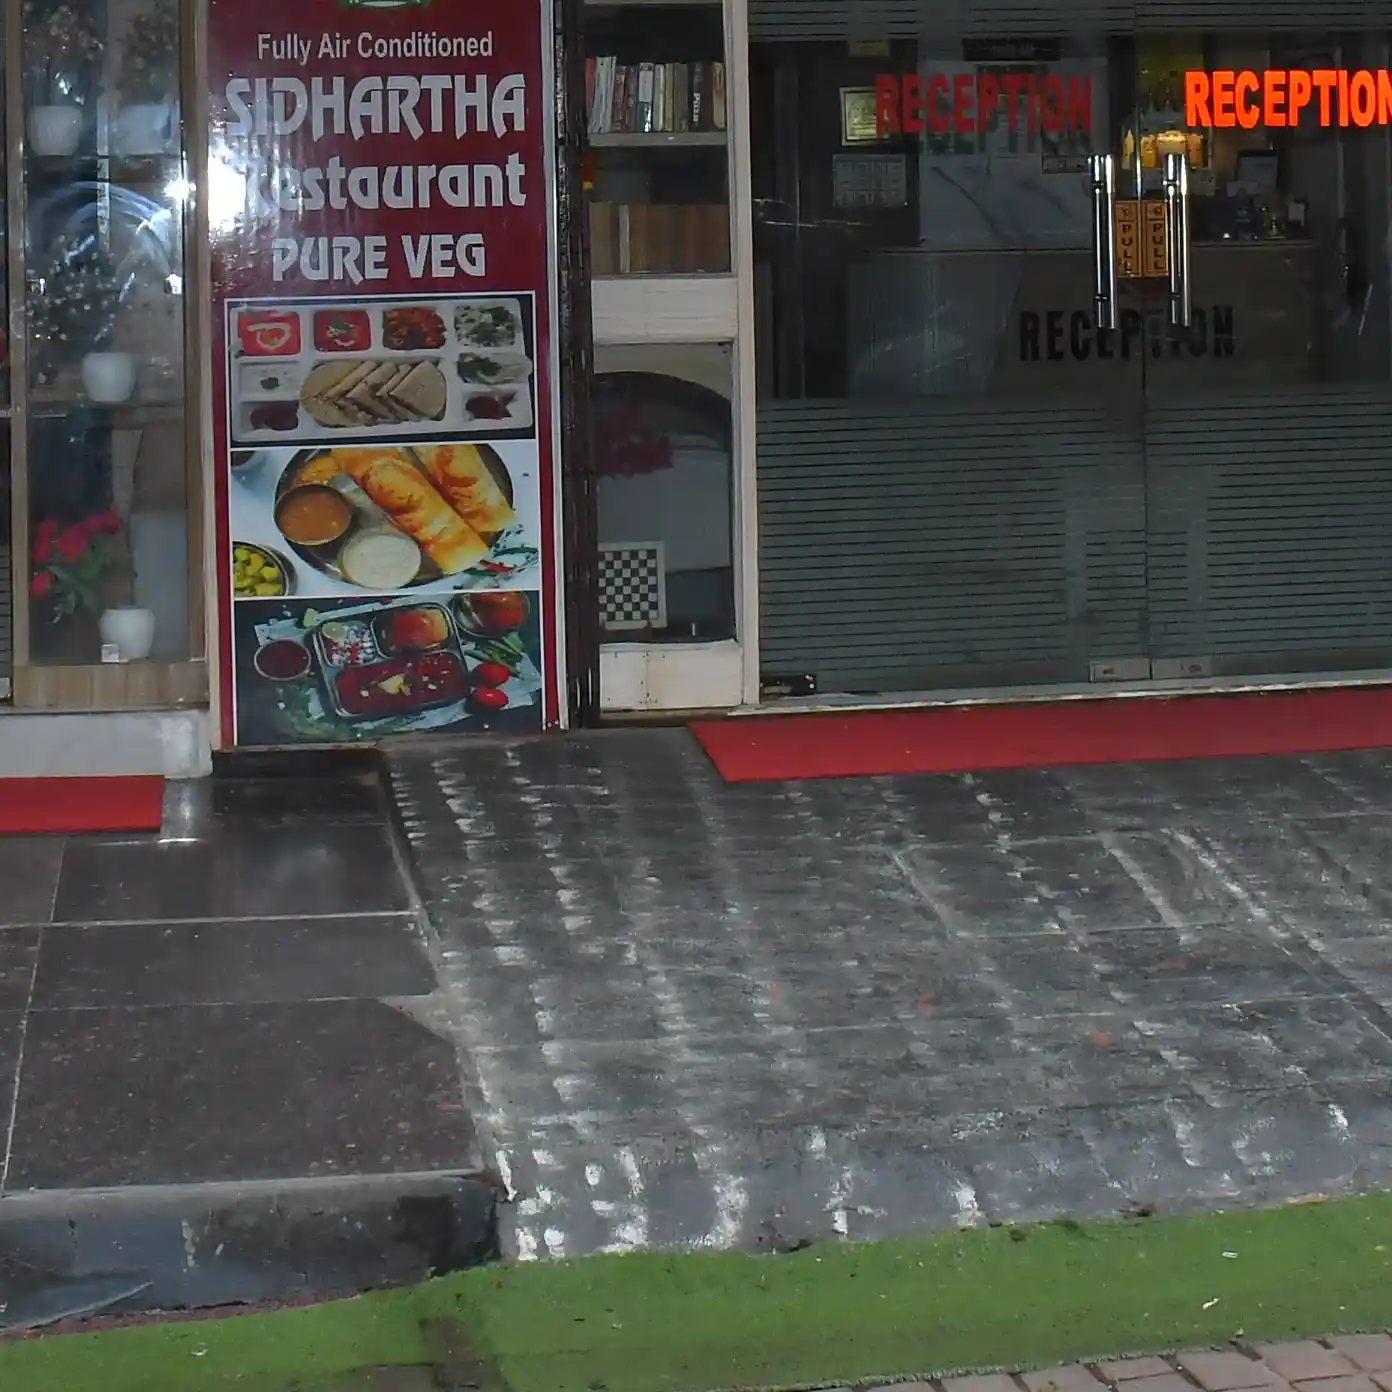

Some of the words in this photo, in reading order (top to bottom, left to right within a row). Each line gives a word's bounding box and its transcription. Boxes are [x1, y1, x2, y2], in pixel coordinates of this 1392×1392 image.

[257, 32, 312, 65] Fully
[318, 32, 351, 59] Air
[357, 30, 493, 59] Conditioned
[225, 73, 527, 142] SIDHARTHA
[874, 73, 1094, 135] RECEPTION
[272, 234, 389, 285] PURE
[401, 233, 486, 279] VEG
[1152, 223, 1165, 270] PULL
